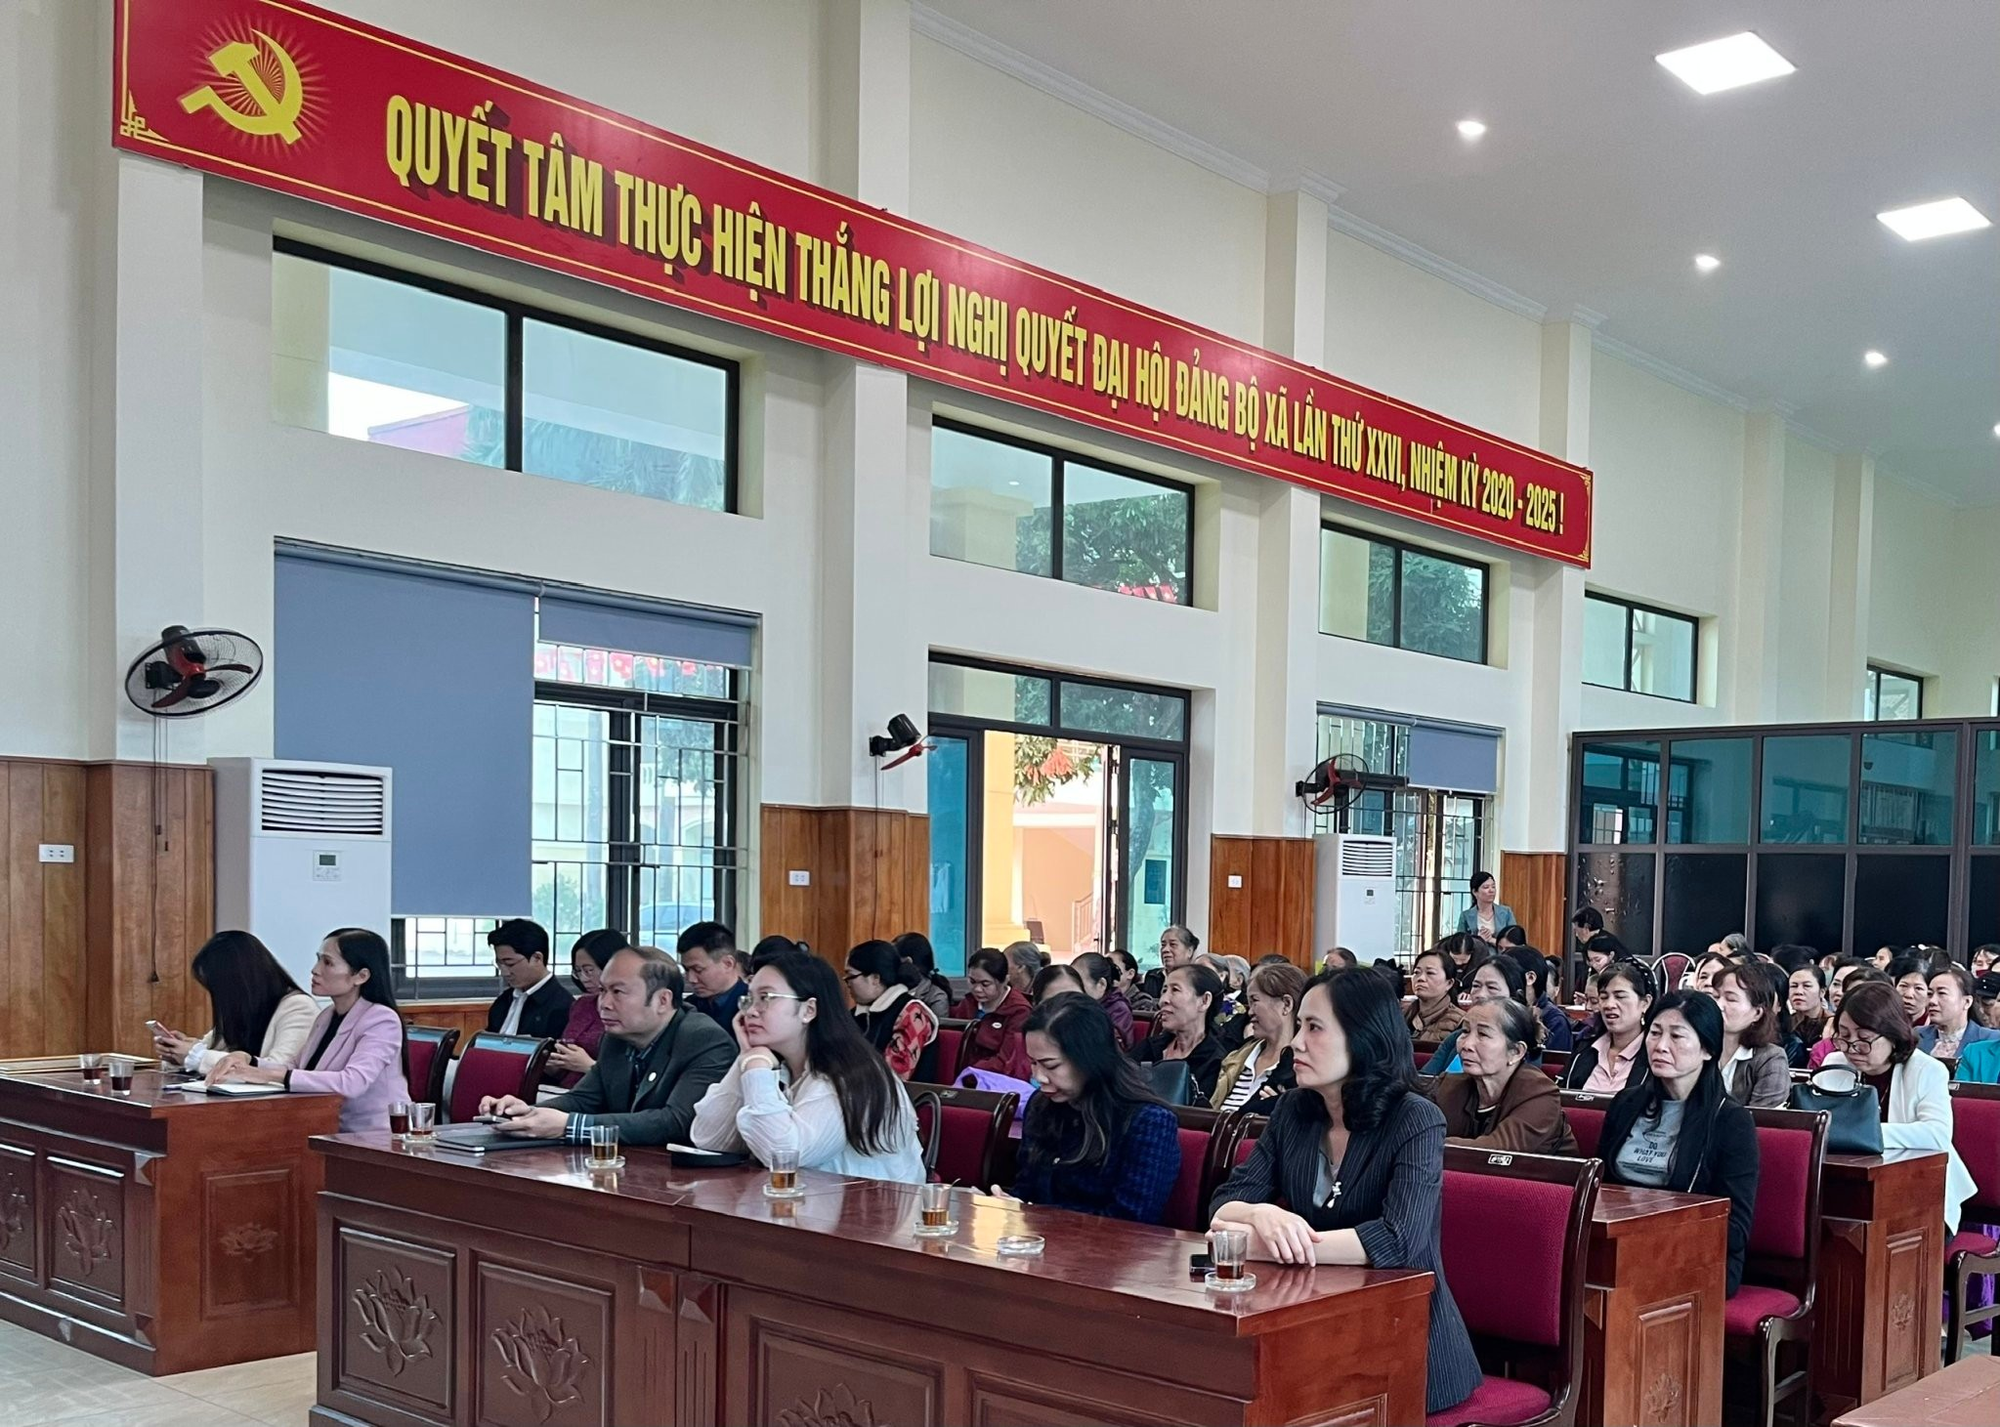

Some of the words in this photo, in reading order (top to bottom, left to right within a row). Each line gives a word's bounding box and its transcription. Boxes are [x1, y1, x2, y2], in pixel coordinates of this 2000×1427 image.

[386, 94, 512, 208] QUYẾT
[523, 131, 603, 237] TÂM
[614, 170, 702, 275] THỰC
[713, 200, 786, 302] HIỆN
[795, 221, 890, 326] THẮNG
[898, 267, 939, 352] LỢI
[947, 282, 1008, 376] NGHỊ
[1015, 305, 1087, 386] QUYẾT
[1092, 333, 1129, 409] ĐẠI
[1136, 341, 1170, 422] HỘI
[1176, 348, 1229, 431] ĐẢNG
[1235, 376, 1259, 451] BỘ
[1264, 385, 1289, 449] XÃ
[1294, 388, 1327, 461] LẦN
[1331, 411, 1364, 472] THỨ
[1366, 426, 1406, 491] XXVI,
[1410, 440, 1458, 508] NHIỆM
[1461, 452, 1479, 508] KỲ
[1482, 467, 1515, 520] 2020
[1525, 482, 1556, 533] 2025
[1648, 1142, 1658, 1150] DO
[1633, 1148, 1653, 1156] WHAT
